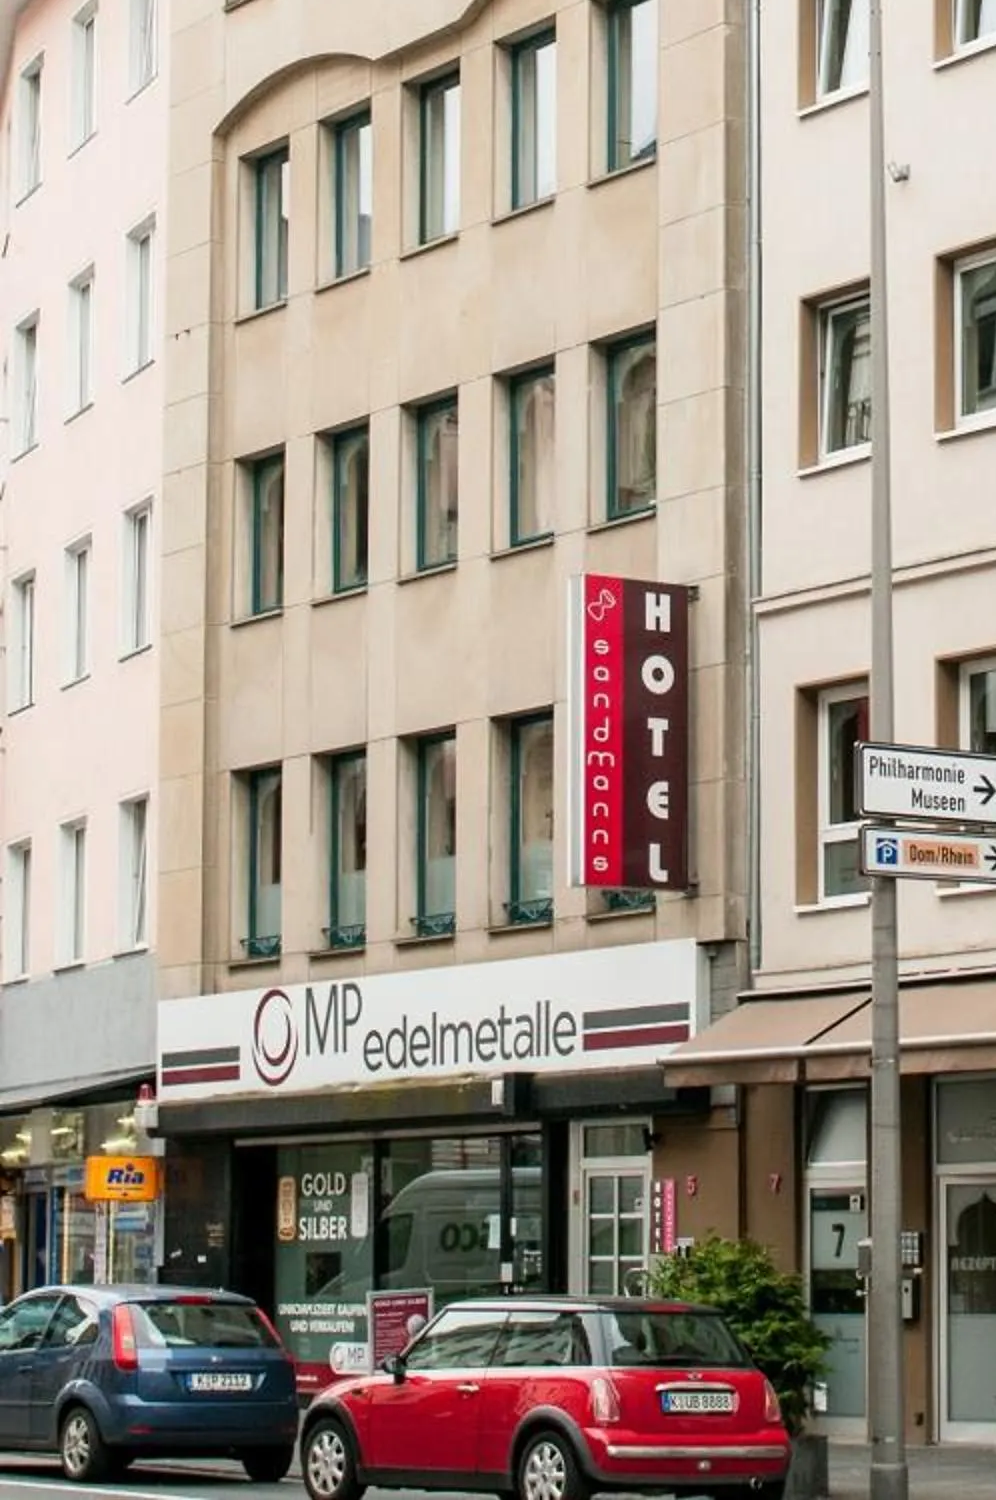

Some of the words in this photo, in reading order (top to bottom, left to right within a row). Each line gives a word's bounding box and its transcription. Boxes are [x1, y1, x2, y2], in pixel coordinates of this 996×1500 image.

[641, 591, 675, 883] HOTEL
[587, 639, 616, 872] sandmanns
[869, 755, 966, 784] Philharmonie
[911, 787, 966, 813] Museen
[909, 844, 975, 866] Dom/Rhein
[305, 982, 363, 1056] MP
[363, 1000, 577, 1072] edelmetalle
[107, 1162, 145, 1184] Ria
[301, 1171, 346, 1197] GOLD
[299, 1215, 347, 1241] SILBER
[832, 1223, 845, 1258] 7
